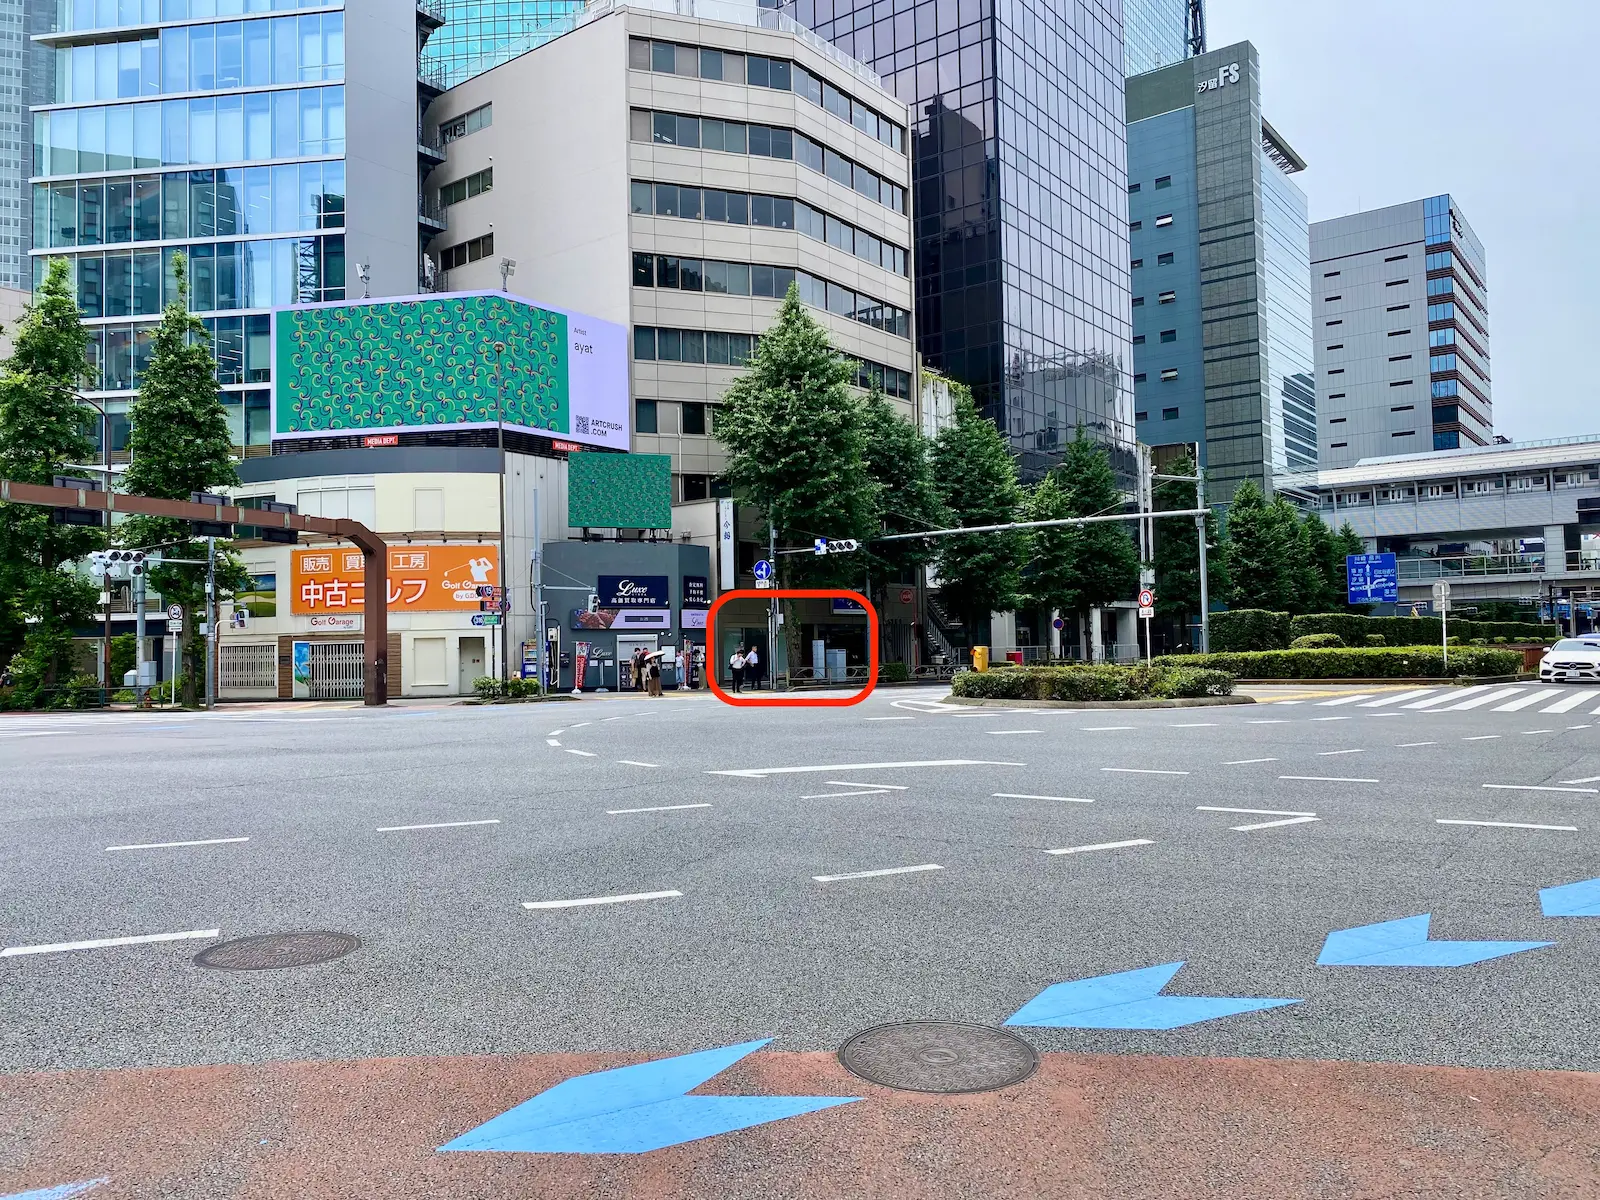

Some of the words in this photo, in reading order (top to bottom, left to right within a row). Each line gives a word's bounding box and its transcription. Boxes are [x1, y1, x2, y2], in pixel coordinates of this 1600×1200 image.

[573, 327, 587, 336] Artist
[574, 342, 593, 354] ayat
[590, 419, 623, 431] ARTCRUSH
[303, 557, 330, 572] 販売
[393, 554, 426, 568] 工房
[441, 580, 461, 590] Golf
[485, 586, 492, 594] 15
[616, 580, 648, 596] Luxe
[310, 616, 327, 626] Golf
[328, 616, 354, 627] Garage
